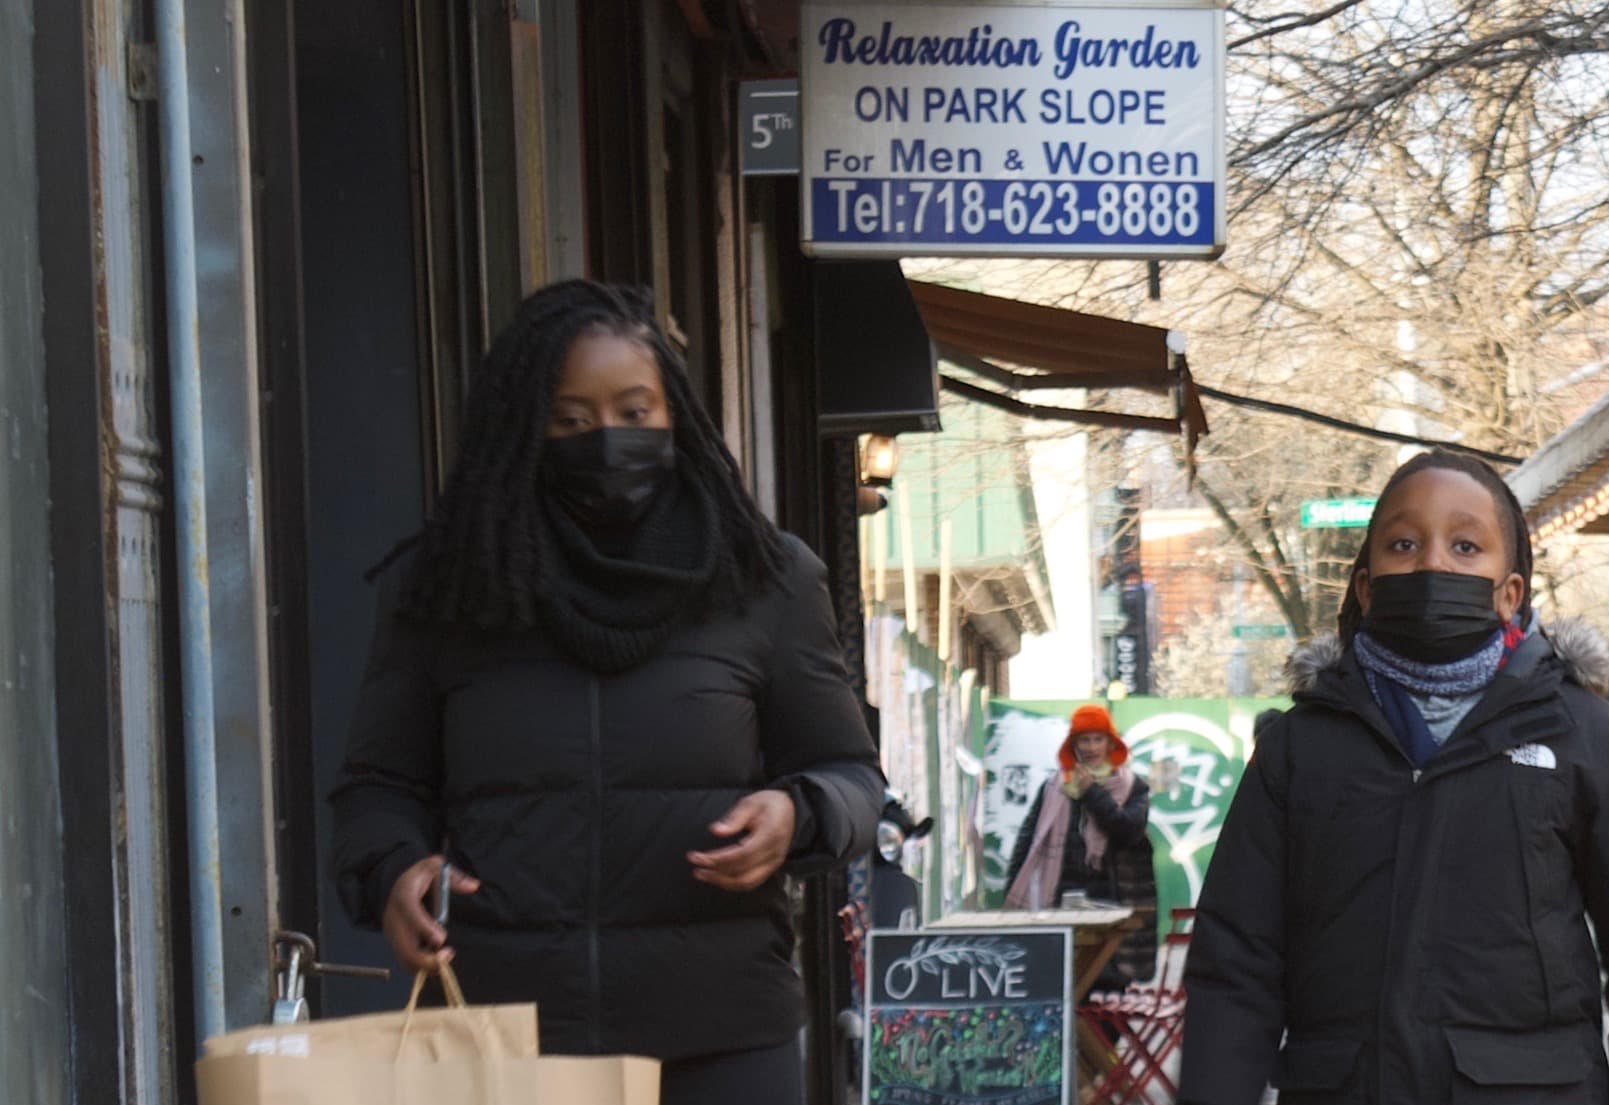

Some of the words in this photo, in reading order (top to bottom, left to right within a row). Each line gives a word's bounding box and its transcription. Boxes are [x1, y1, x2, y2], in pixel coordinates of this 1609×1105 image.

[818, 17, 1042, 68] Relaxation
[1053, 20, 1200, 80] Garden
[855, 85, 909, 122] ON
[924, 87, 1027, 123] PARK
[1040, 88, 1166, 125] SLOPE
[824, 149, 874, 172] For
[890, 138, 982, 173] Men
[1004, 149, 1024, 171] &
[1042, 141, 1199, 177] Wonen
[828, 180, 1200, 237] Tel:718-623-8888
[885, 960, 1028, 999] OLIVE
